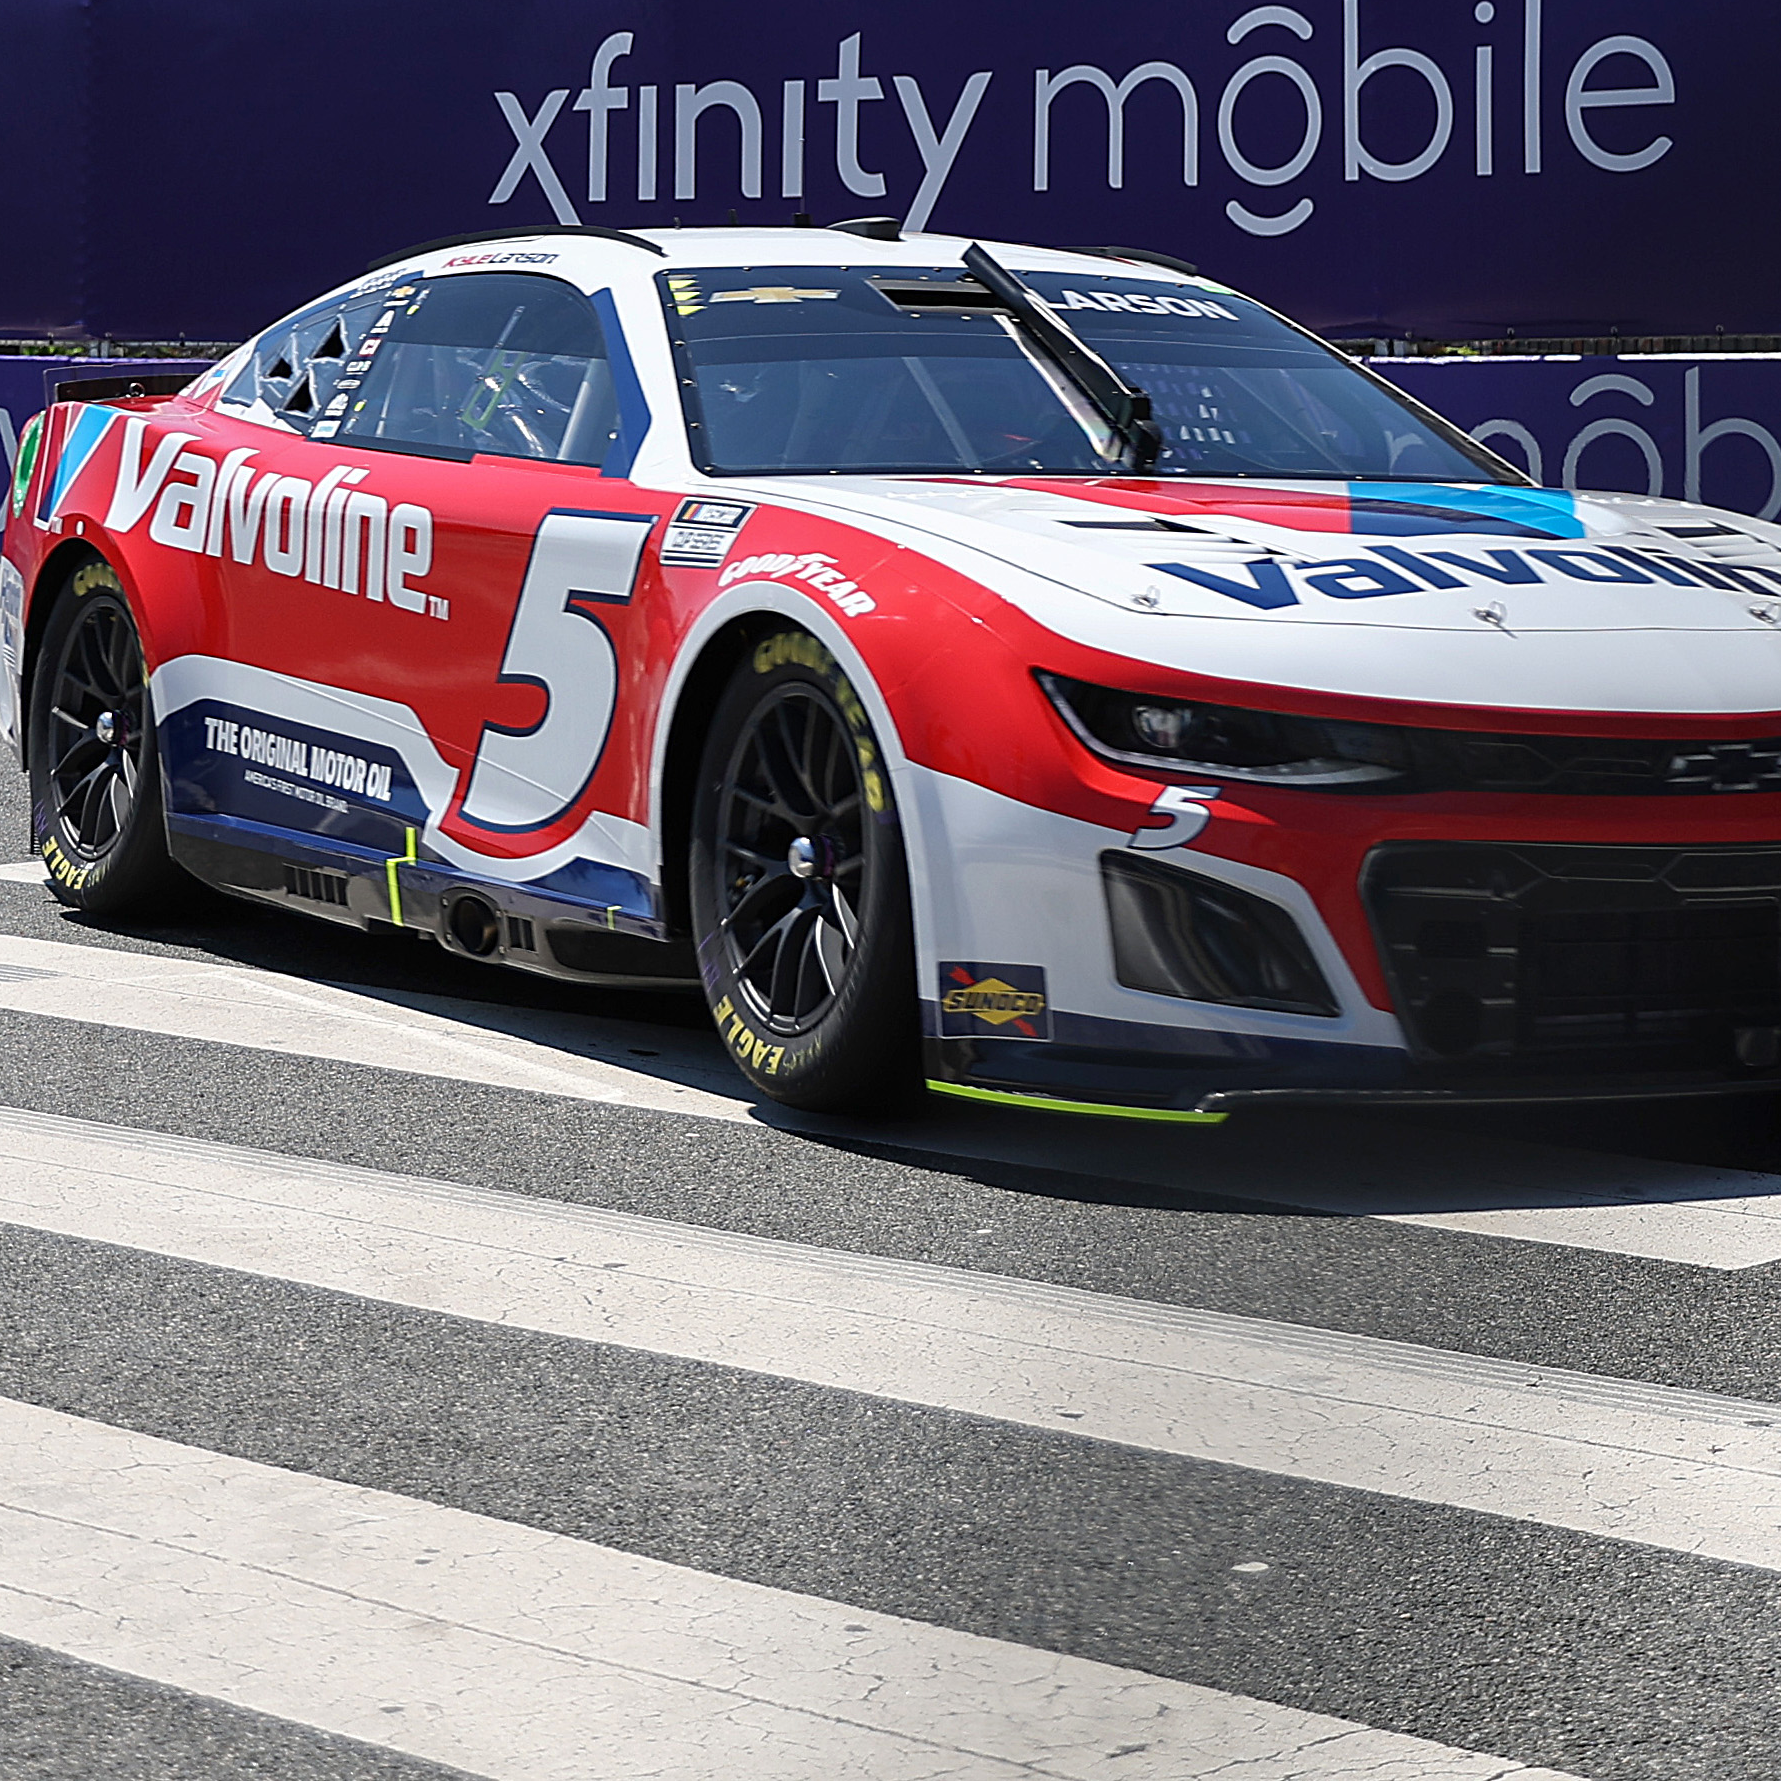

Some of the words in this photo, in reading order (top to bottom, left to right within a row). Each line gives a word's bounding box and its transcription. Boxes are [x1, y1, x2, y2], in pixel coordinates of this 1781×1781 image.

[488, 29, 993, 232] xfinity
[1029, 289, 1240, 321] LARSON
[103, 416, 433, 615] Valvoline
[718, 552, 878, 618] GOODYEAR
[449, 507, 659, 835] 5
[204, 716, 239, 756] THE
[239, 726, 309, 778] ORIGINAL
[309, 745, 368, 795] MOTOR
[366, 762, 393, 802] OIL
[1126, 785, 1224, 851] 5
[41, 834, 89, 891] EAGLE
[712, 993, 786, 1076] EAGLE
[944, 990, 1042, 1015] SUNOCO
